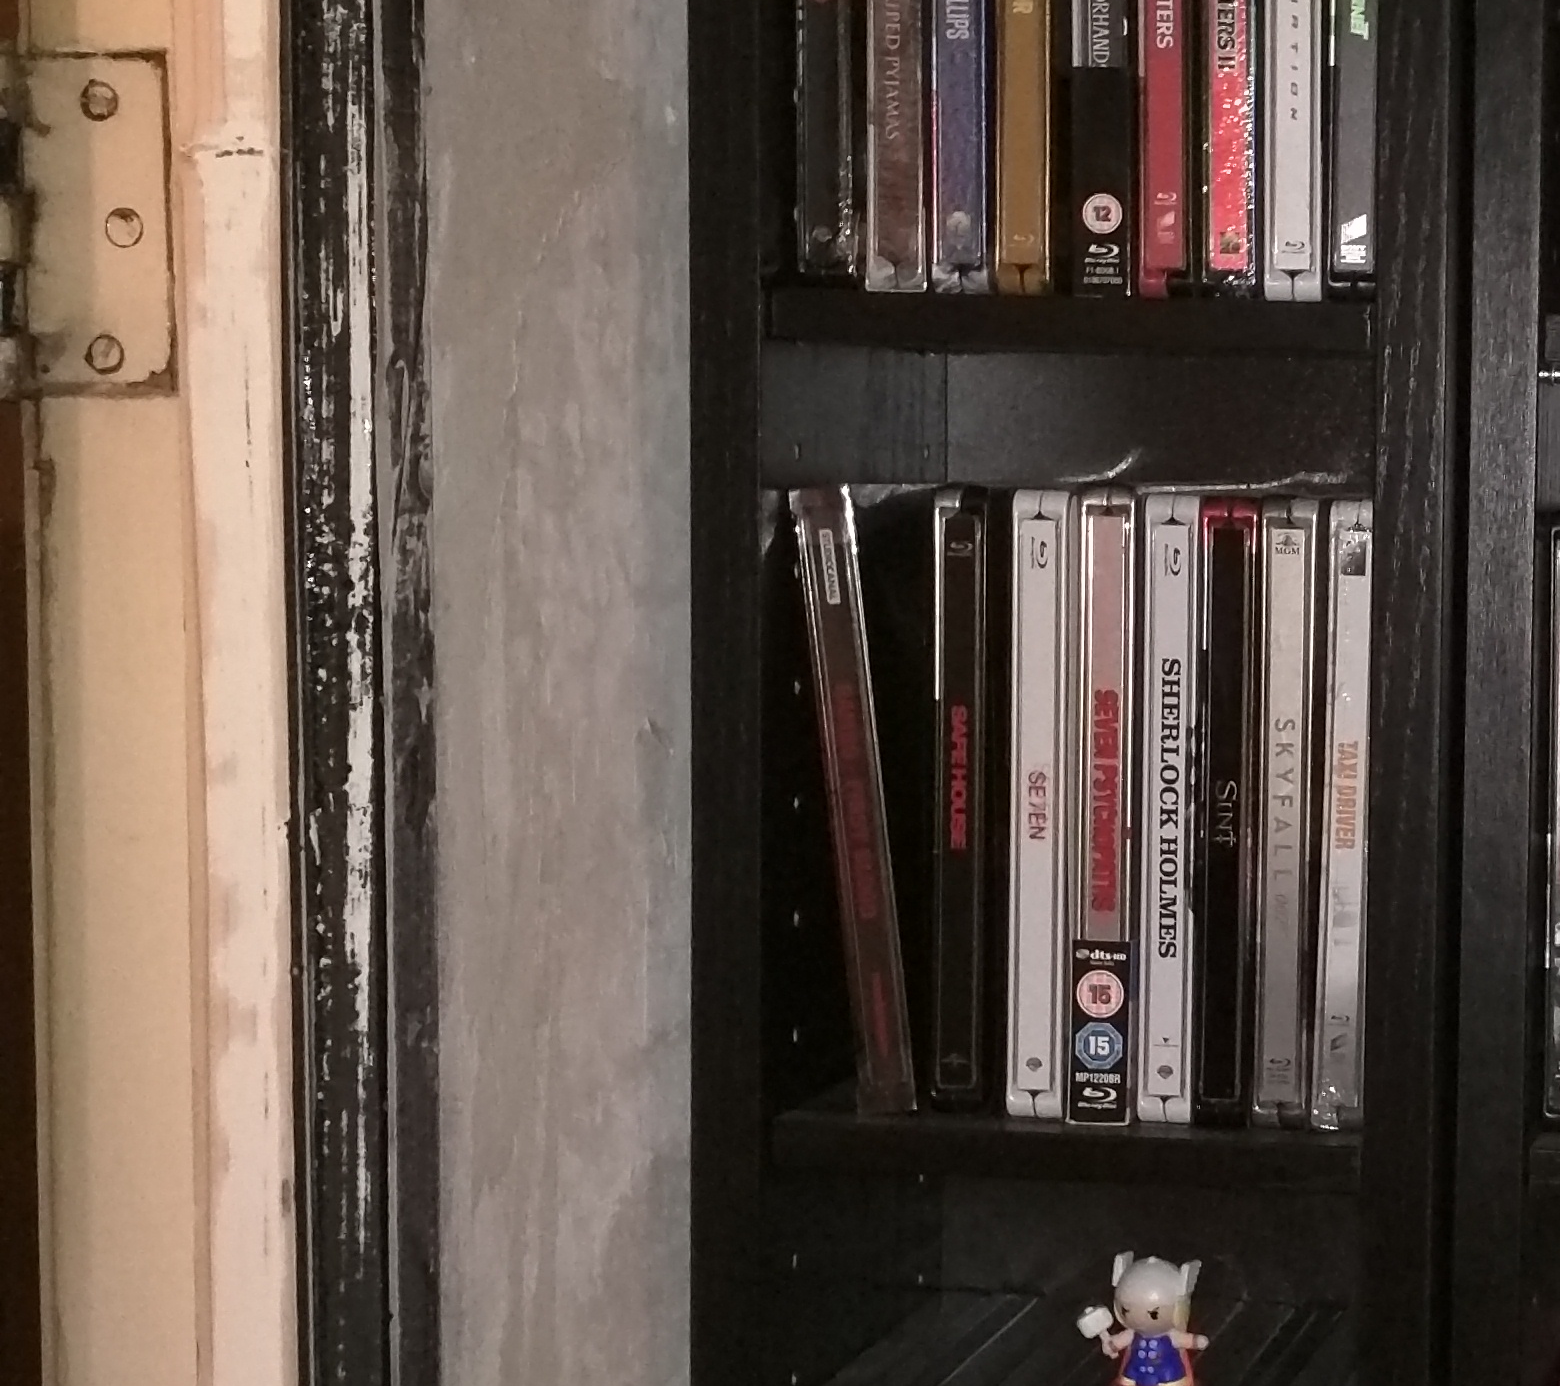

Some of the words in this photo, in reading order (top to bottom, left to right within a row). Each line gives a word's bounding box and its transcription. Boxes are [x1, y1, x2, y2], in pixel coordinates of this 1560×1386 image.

[885, 56, 900, 140] PYJAMAS
[1094, 205, 1112, 223] 12
[1275, 546, 1300, 556] MGM
[950, 704, 969, 766] SAFE
[1093, 689, 1119, 759] SEVEN
[1160, 657, 1182, 829] SHERLOCK
[1337, 740, 1358, 779] TAXI
[950, 768, 969, 849] HOUSE
[1027, 770, 1048, 840] SE7EN
[1271, 718, 1296, 879] SKYFALL
[1334, 784, 1357, 850] DRIVER
[1091, 762, 1119, 912] PSYCHOPATHS
[1158, 835, 1179, 959] HOLMES
[1088, 983, 1112, 1005] 15
[1088, 1036, 1111, 1055] 15
